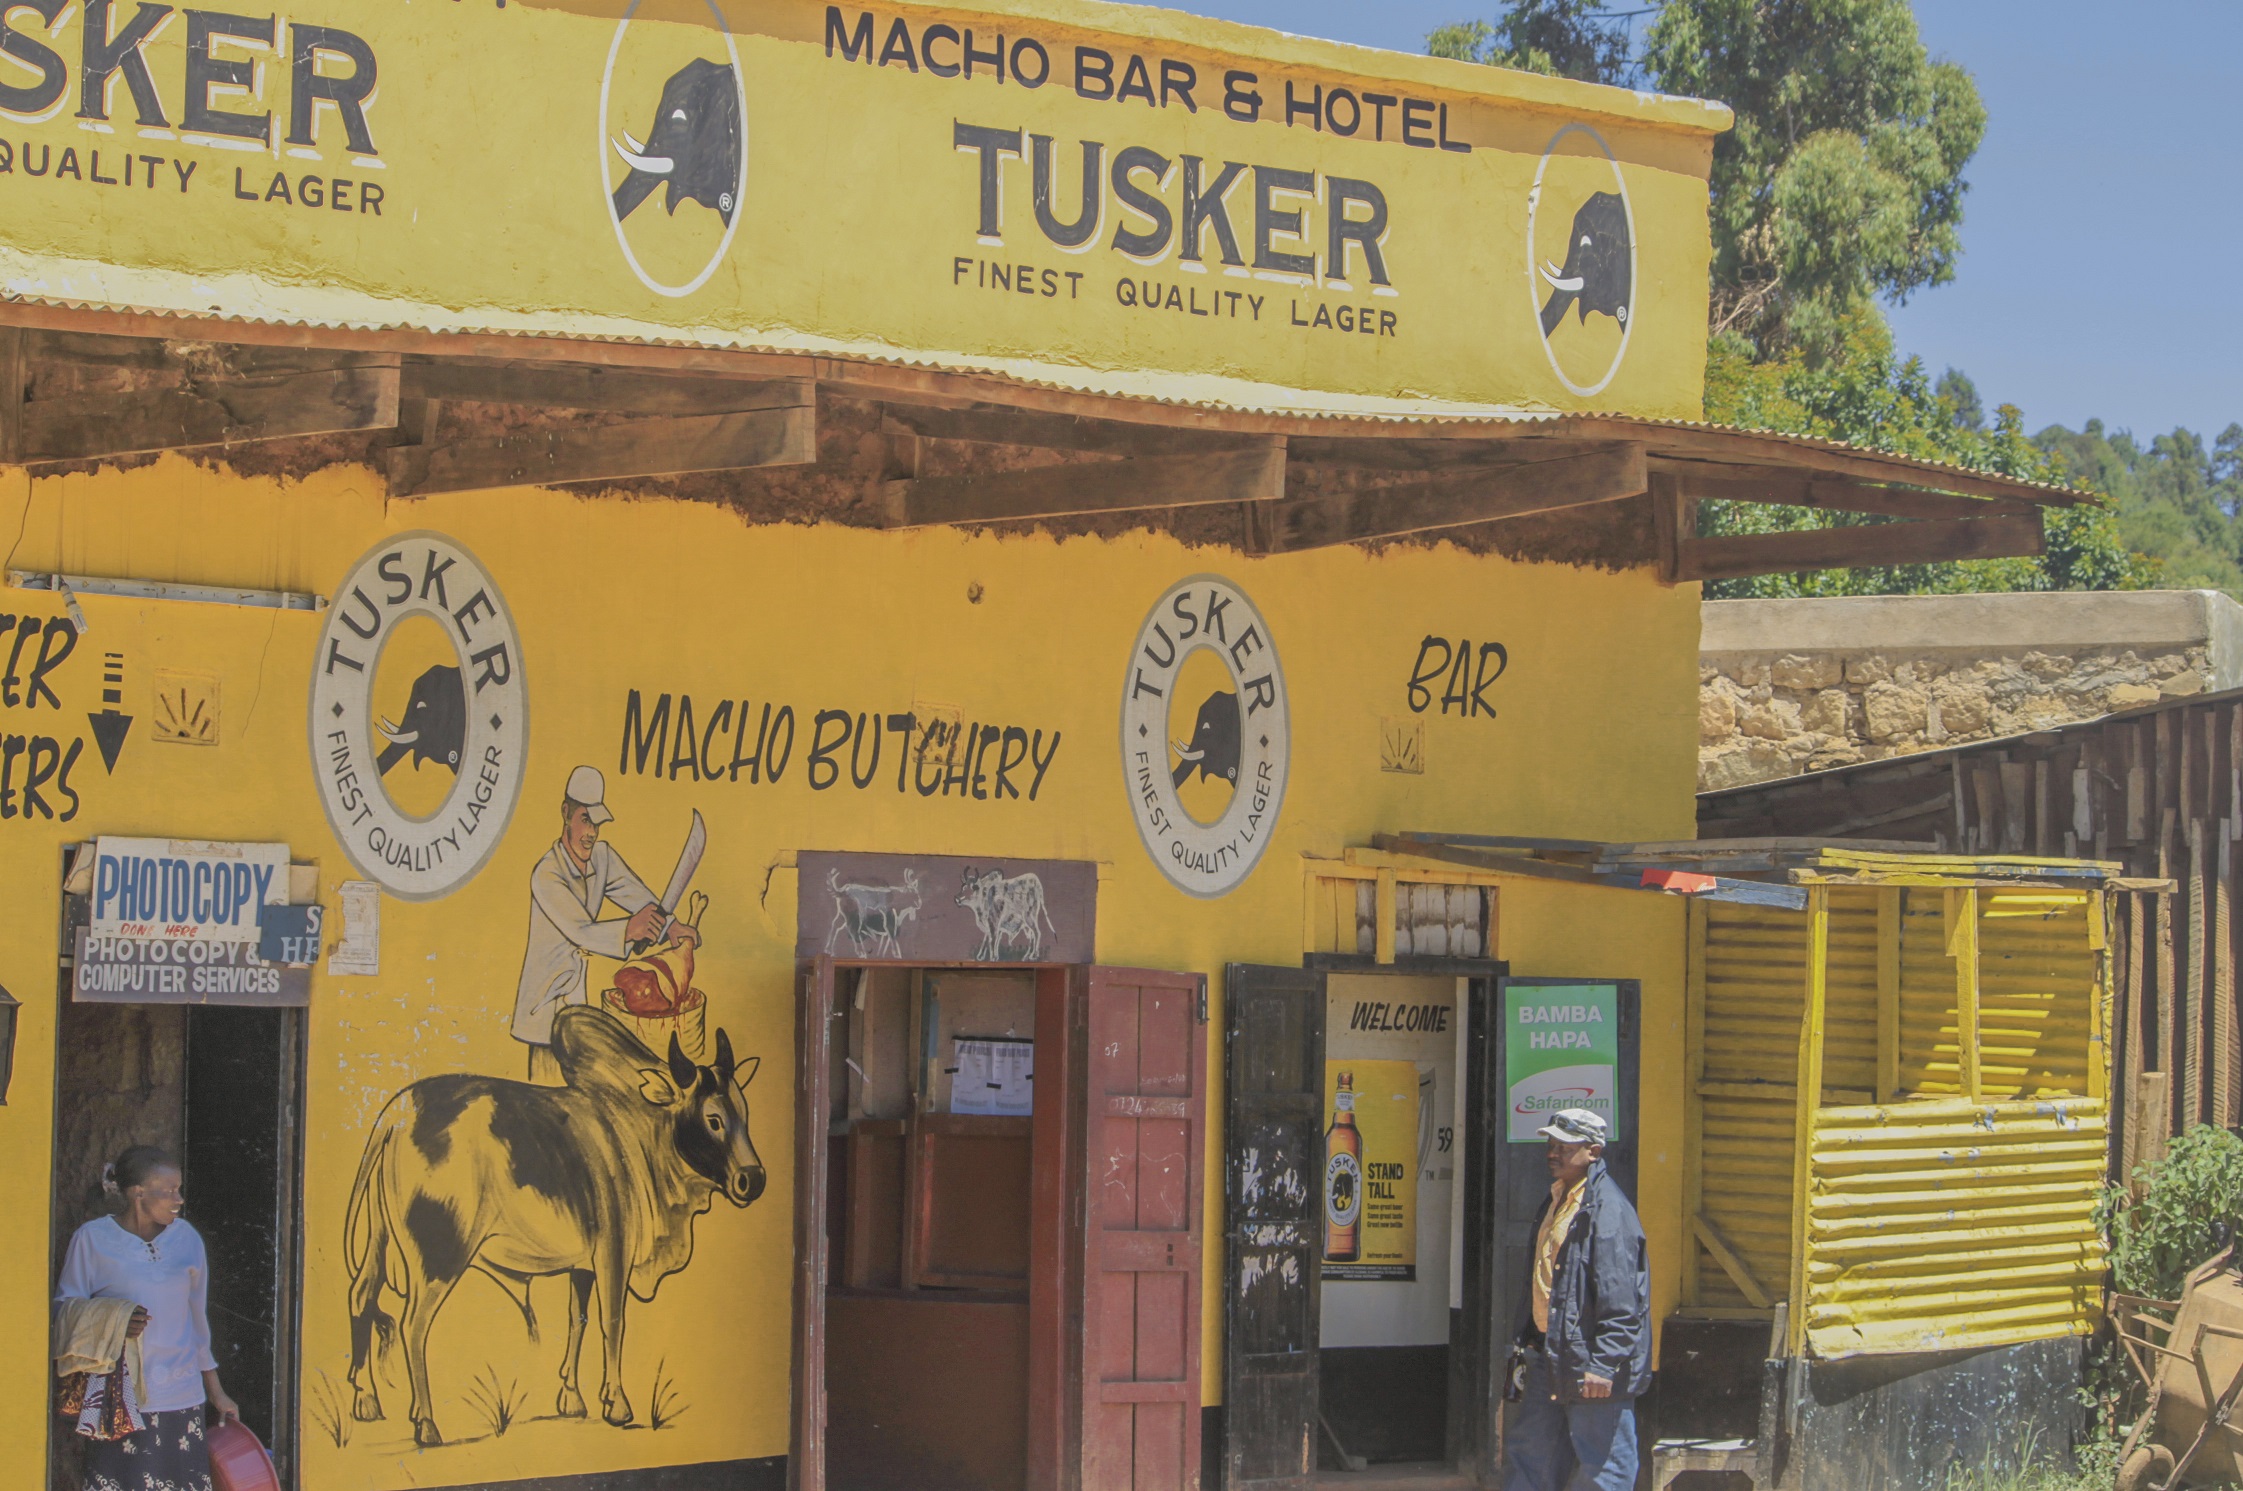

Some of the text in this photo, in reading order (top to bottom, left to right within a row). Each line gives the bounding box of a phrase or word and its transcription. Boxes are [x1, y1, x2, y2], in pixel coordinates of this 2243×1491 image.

[824, 4, 1473, 154] MACHO BAR & HOTEL
[235, 166, 386, 217] LAGER
[953, 117, 1394, 290] TUSKER
[953, 256, 1398, 337] FINEST QUALITY LAGER
[324, 548, 511, 697] TUSKER
[1131, 588, 1276, 721] TUSKER
[0, 612, 79, 711] ER
[1406, 634, 1508, 719] BAR
[0, 731, 84, 823] ERS
[619, 688, 1062, 802] MACHO BUTCHERY
[327, 730, 503, 872] FINEST QUALITY LAGER
[1135, 750, 1274, 875] FINEST QUALITY LAGER
[95, 854, 275, 928] PHOTOCOPY
[164, 924, 199, 938] HERE
[245, 942, 261, 966] &
[79, 963, 280, 994] COMPUTER SERVICES
[1518, 1005, 1603, 1024] BAMBA
[1350, 1001, 1451, 1034] WELCOME
[1529, 1031, 1592, 1050] HAPA
[1523, 1095, 1610, 1110] Safaricom
[1367, 1162, 1404, 1180] STAND
[1367, 1181, 1396, 1199] TALL
